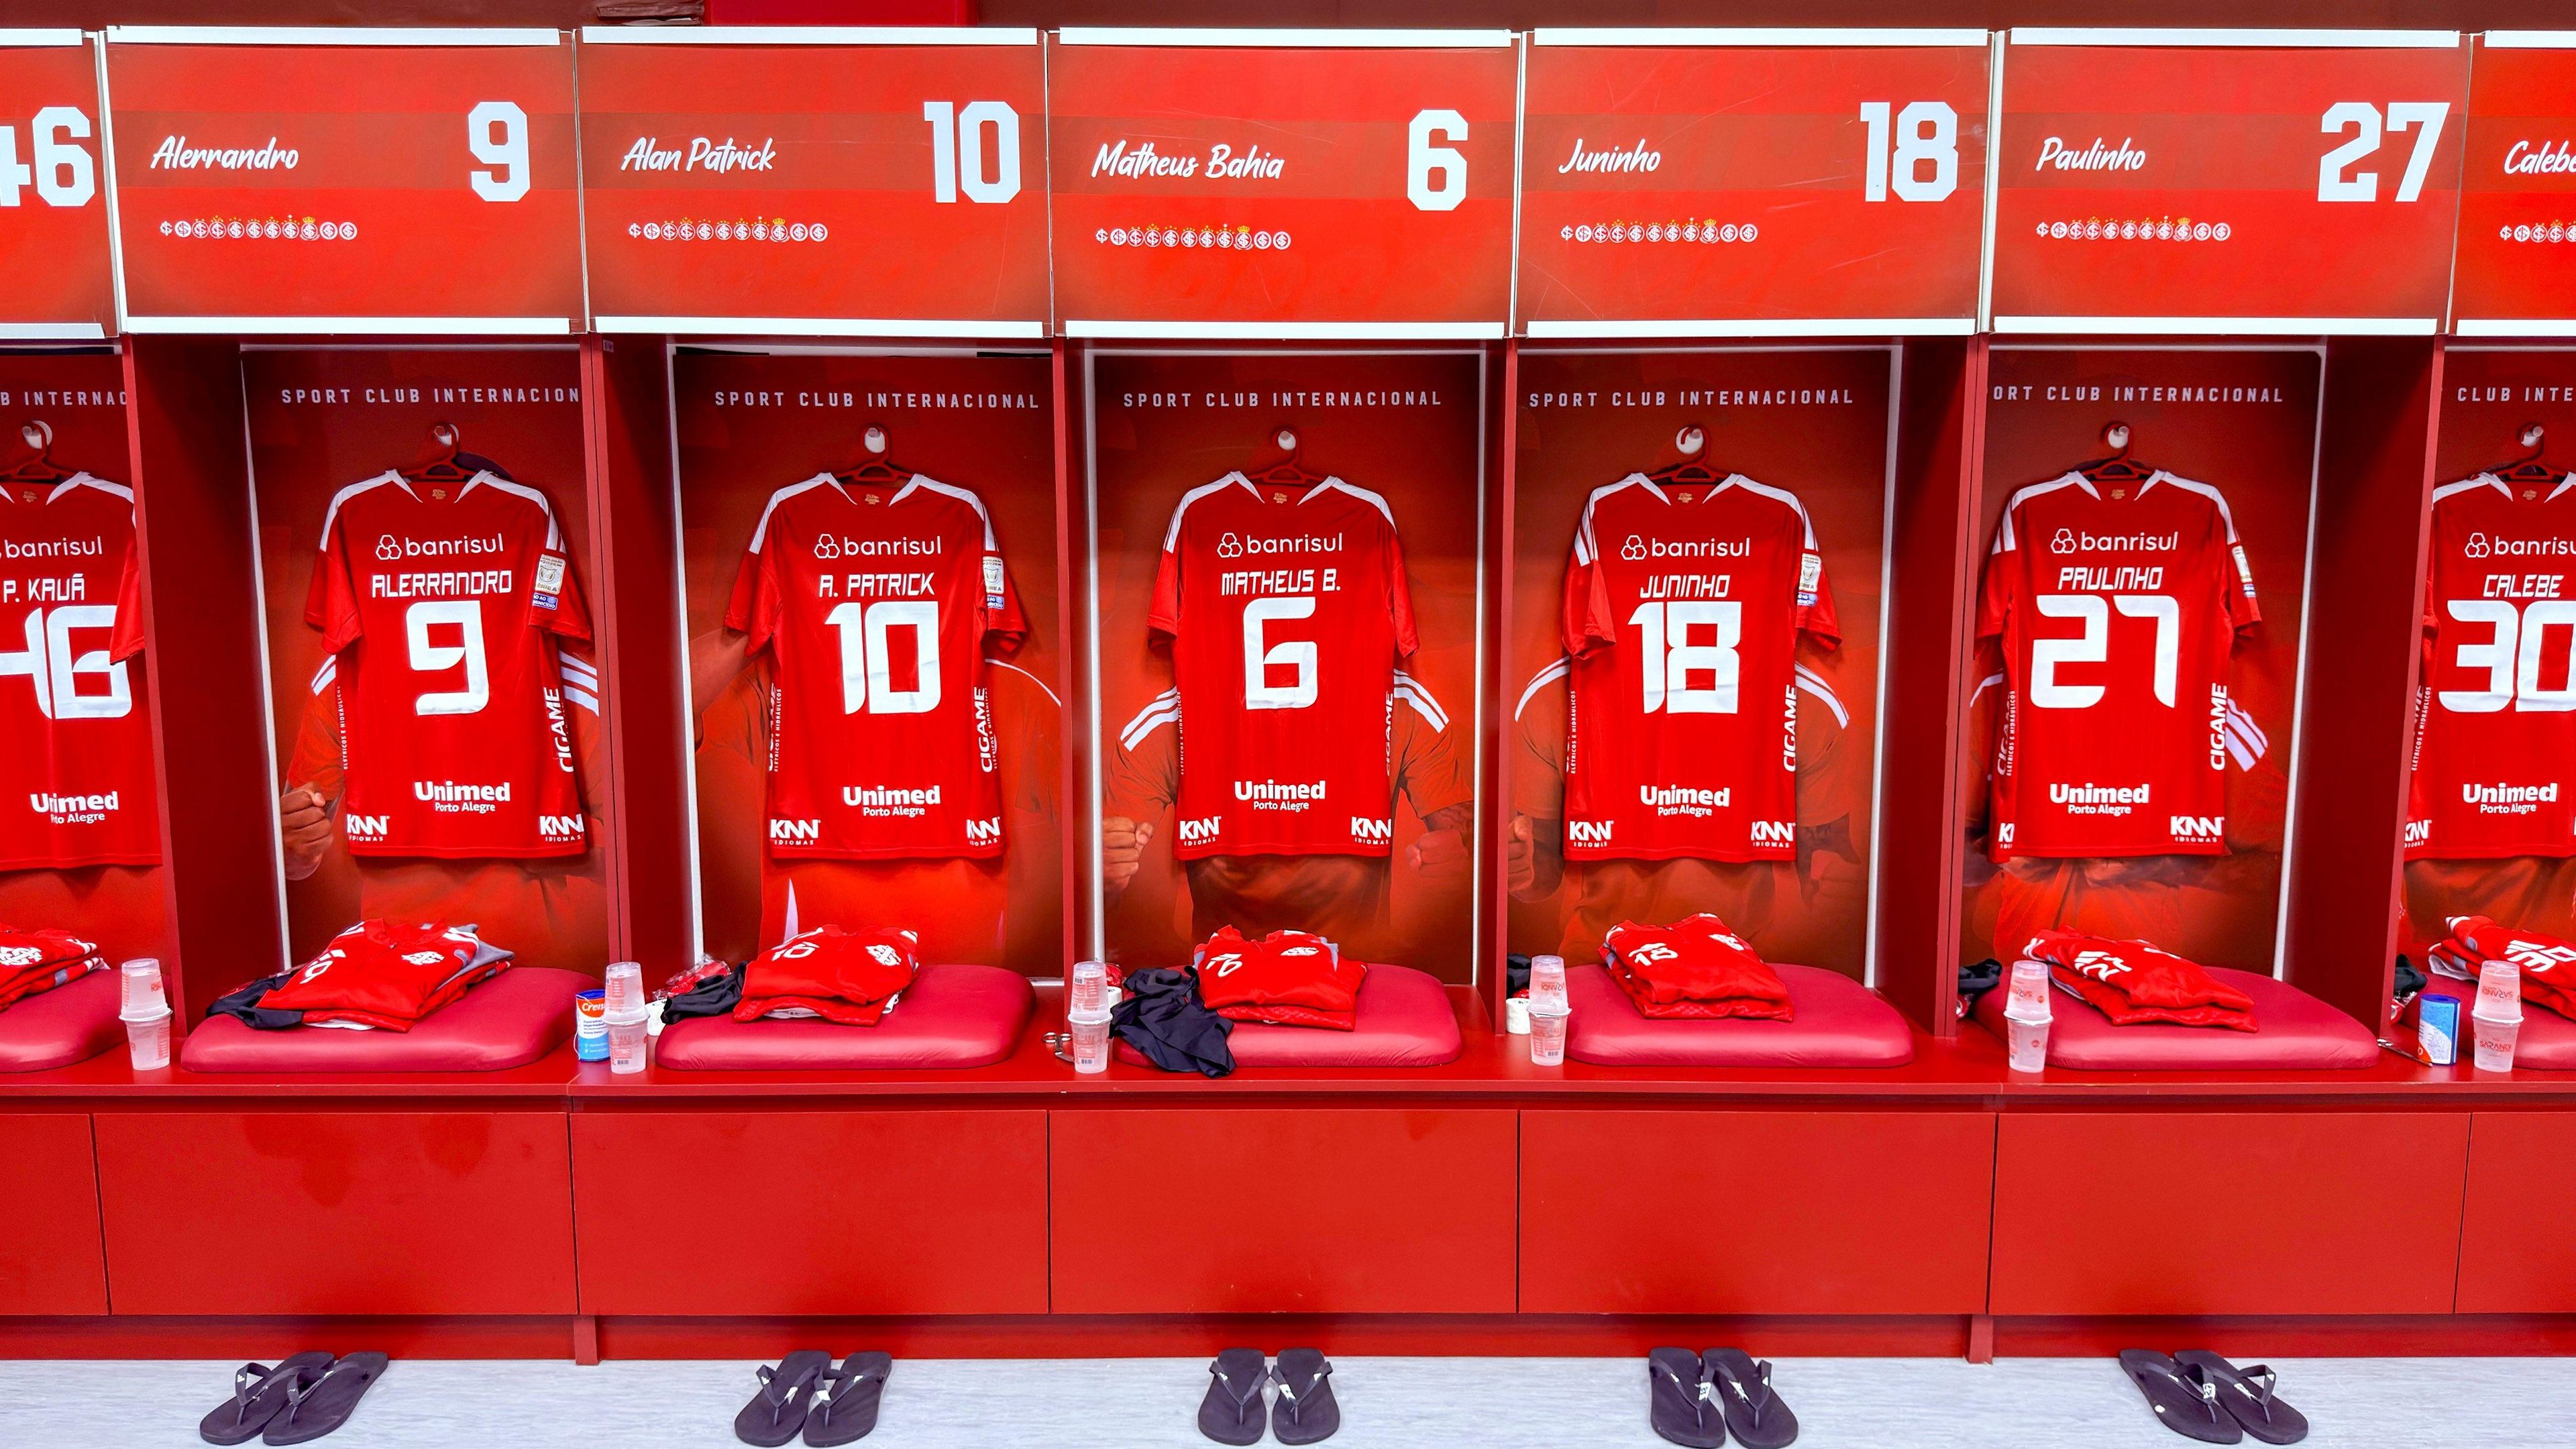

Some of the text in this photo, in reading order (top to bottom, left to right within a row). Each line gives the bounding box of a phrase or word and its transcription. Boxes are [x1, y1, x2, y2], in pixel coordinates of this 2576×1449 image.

[150, 136, 299, 169] Alerrandro
[468, 102, 530, 201] 9
[621, 138, 775, 173] Alan Patrick
[924, 101, 1020, 203] 10
[1091, 140, 1285, 179] Matheus Bahia
[1407, 109, 1468, 211] 6
[1559, 139, 1660, 173] Juninho
[1860, 102, 1958, 201] 18
[2036, 137, 2145, 171] Paulinho
[2318, 103, 2451, 201] 27
[2504, 140, 2576, 174] Calebe
[282, 389, 350, 402] SPORT
[366, 389, 419, 402] CLUB
[716, 392, 1038, 408] SPORT CLUB INTERNACIONAL
[1124, 392, 1440, 407] SPORT CLUB INTERNACIONAL
[1530, 390, 1852, 407] SPORT CLUB INTERNACIONAL
[2047, 386, 2100, 400] CLUB
[2114, 387, 2282, 402] INTERNACIONAL
[2458, 388, 2510, 401] CLUB
[5, 536, 102, 557] banrisul
[406, 533, 503, 555] banrisul
[845, 536, 941, 555] banrisul
[1247, 533, 1342, 553] banrisul
[1652, 538, 1750, 557] banrisul
[2081, 532, 2178, 551] banrisul
[3, 574, 84, 602] P. KAUÃ
[372, 571, 511, 598] ALERRANDRO
[819, 573, 934, 597] A. PATRICK
[1222, 569, 1340, 595] MATHEUS B.
[1640, 575, 1730, 598] JUNINHO
[2058, 568, 2163, 590] PAULINHO
[2483, 575, 2563, 598] CALEBE
[406, 600, 489, 715] 9
[825, 601, 941, 714] 10
[1243, 597, 1318, 710] 6
[1628, 601, 1741, 714] 18
[2031, 595, 2179, 708] 27
[2438, 600, 2576, 712] 30
[544, 687, 574, 773] CIGAME
[974, 686, 992, 773] CIGAME
[1385, 690, 1393, 776] CIGAME
[1784, 684, 1796, 772] CIGAME
[2210, 682, 2228, 770] CIGAME
[2412, 737, 2422, 771] ELÉTRICOS
[2419, 687, 2431, 730] HIDRÁULICOS
[2006, 741, 2015, 776] ELÉTRICOS
[415, 781, 510, 801] Unimed
[844, 786, 941, 806] Unimed
[1235, 780, 1326, 800] Unimed
[1640, 784, 1730, 807] Unimed
[2050, 783, 2149, 803] Unimed
[2463, 783, 2557, 803] Unimed
[435, 802, 495, 814] Porto Alegre
[863, 806, 924, 817] Porto Alegre
[1254, 801, 1309, 812] Porto Alegre
[1658, 806, 1712, 818] Porto Alegre
[2068, 804, 2131, 816] Porto Alegre
[2481, 803, 2536, 814] Porto Alegre
[67, 813, 105, 824] Alegre
[347, 814, 386, 835] KNN
[539, 813, 584, 835] KNN
[770, 819, 818, 839] KNN
[1180, 816, 1220, 840] KNN
[1351, 816, 1391, 839] KNN
[2170, 816, 2222, 837] KNN
[1184, 837, 1216, 846] IDIOMAS
[1569, 820, 1611, 841] KNN
[1751, 820, 1794, 841] KNN
